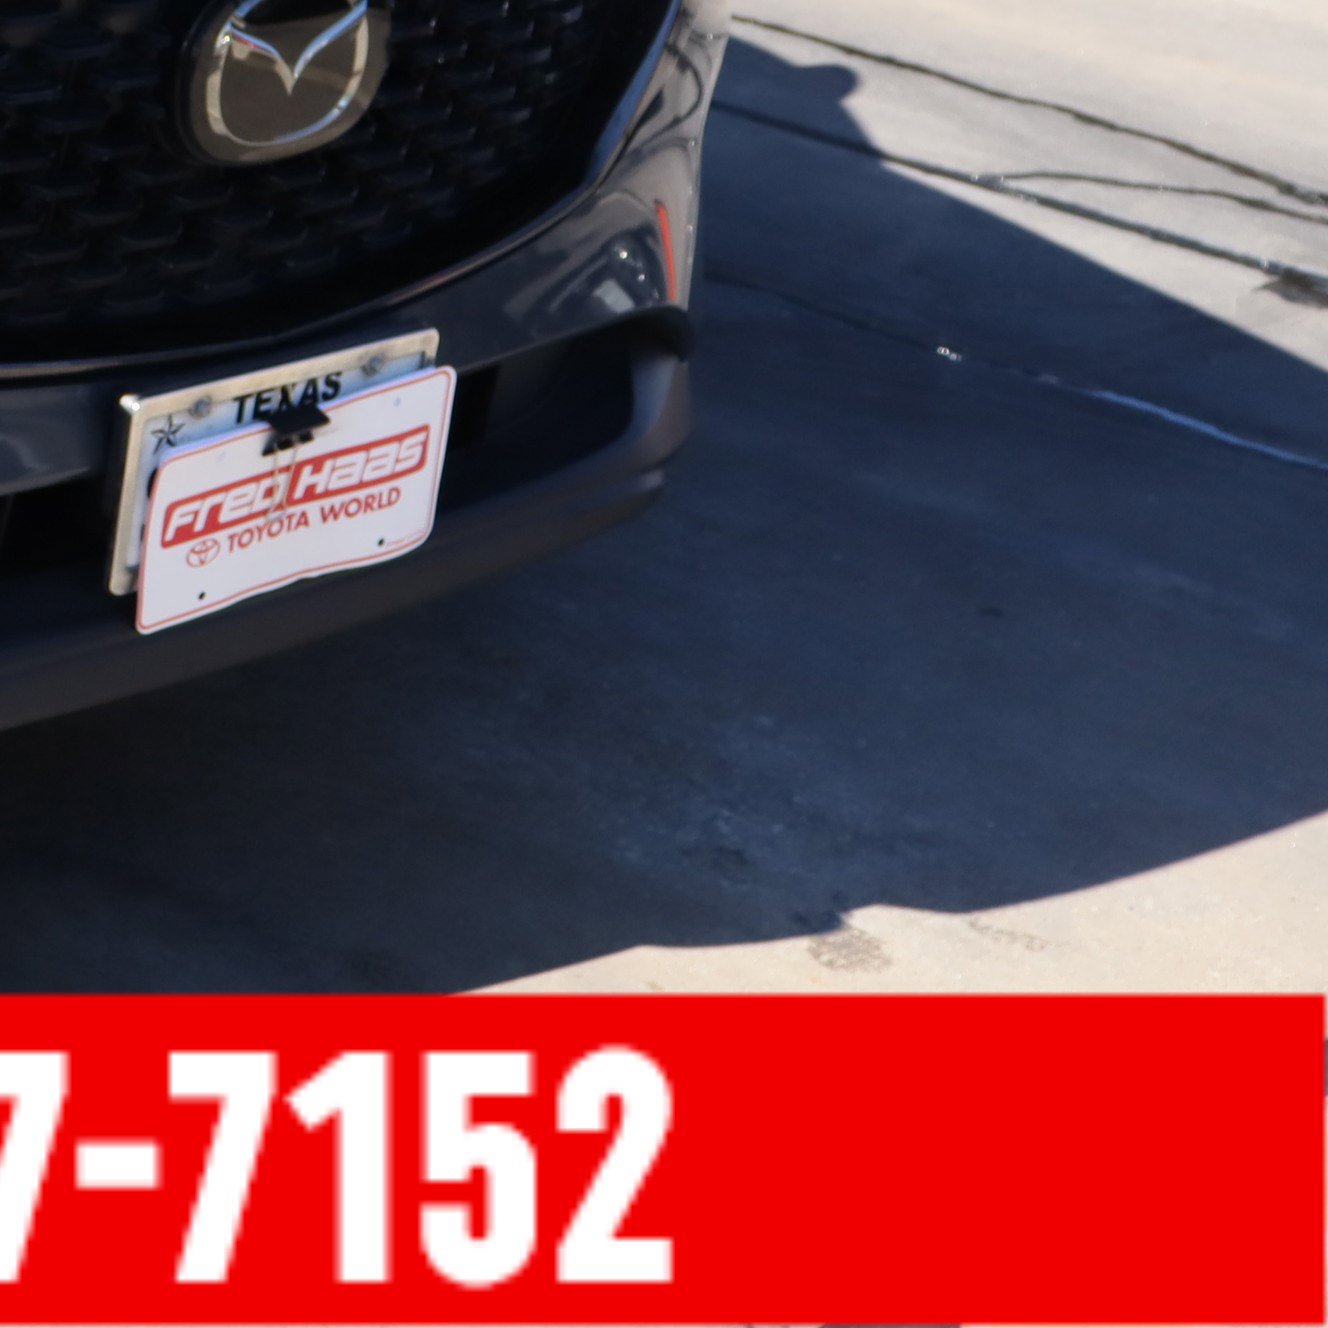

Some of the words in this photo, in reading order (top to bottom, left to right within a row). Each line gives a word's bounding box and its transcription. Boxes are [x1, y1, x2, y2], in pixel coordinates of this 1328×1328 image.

[233, 371, 342, 424] TEXAS
[228, 510, 310, 553] TOYOTA
[320, 486, 401, 523] WORLD
